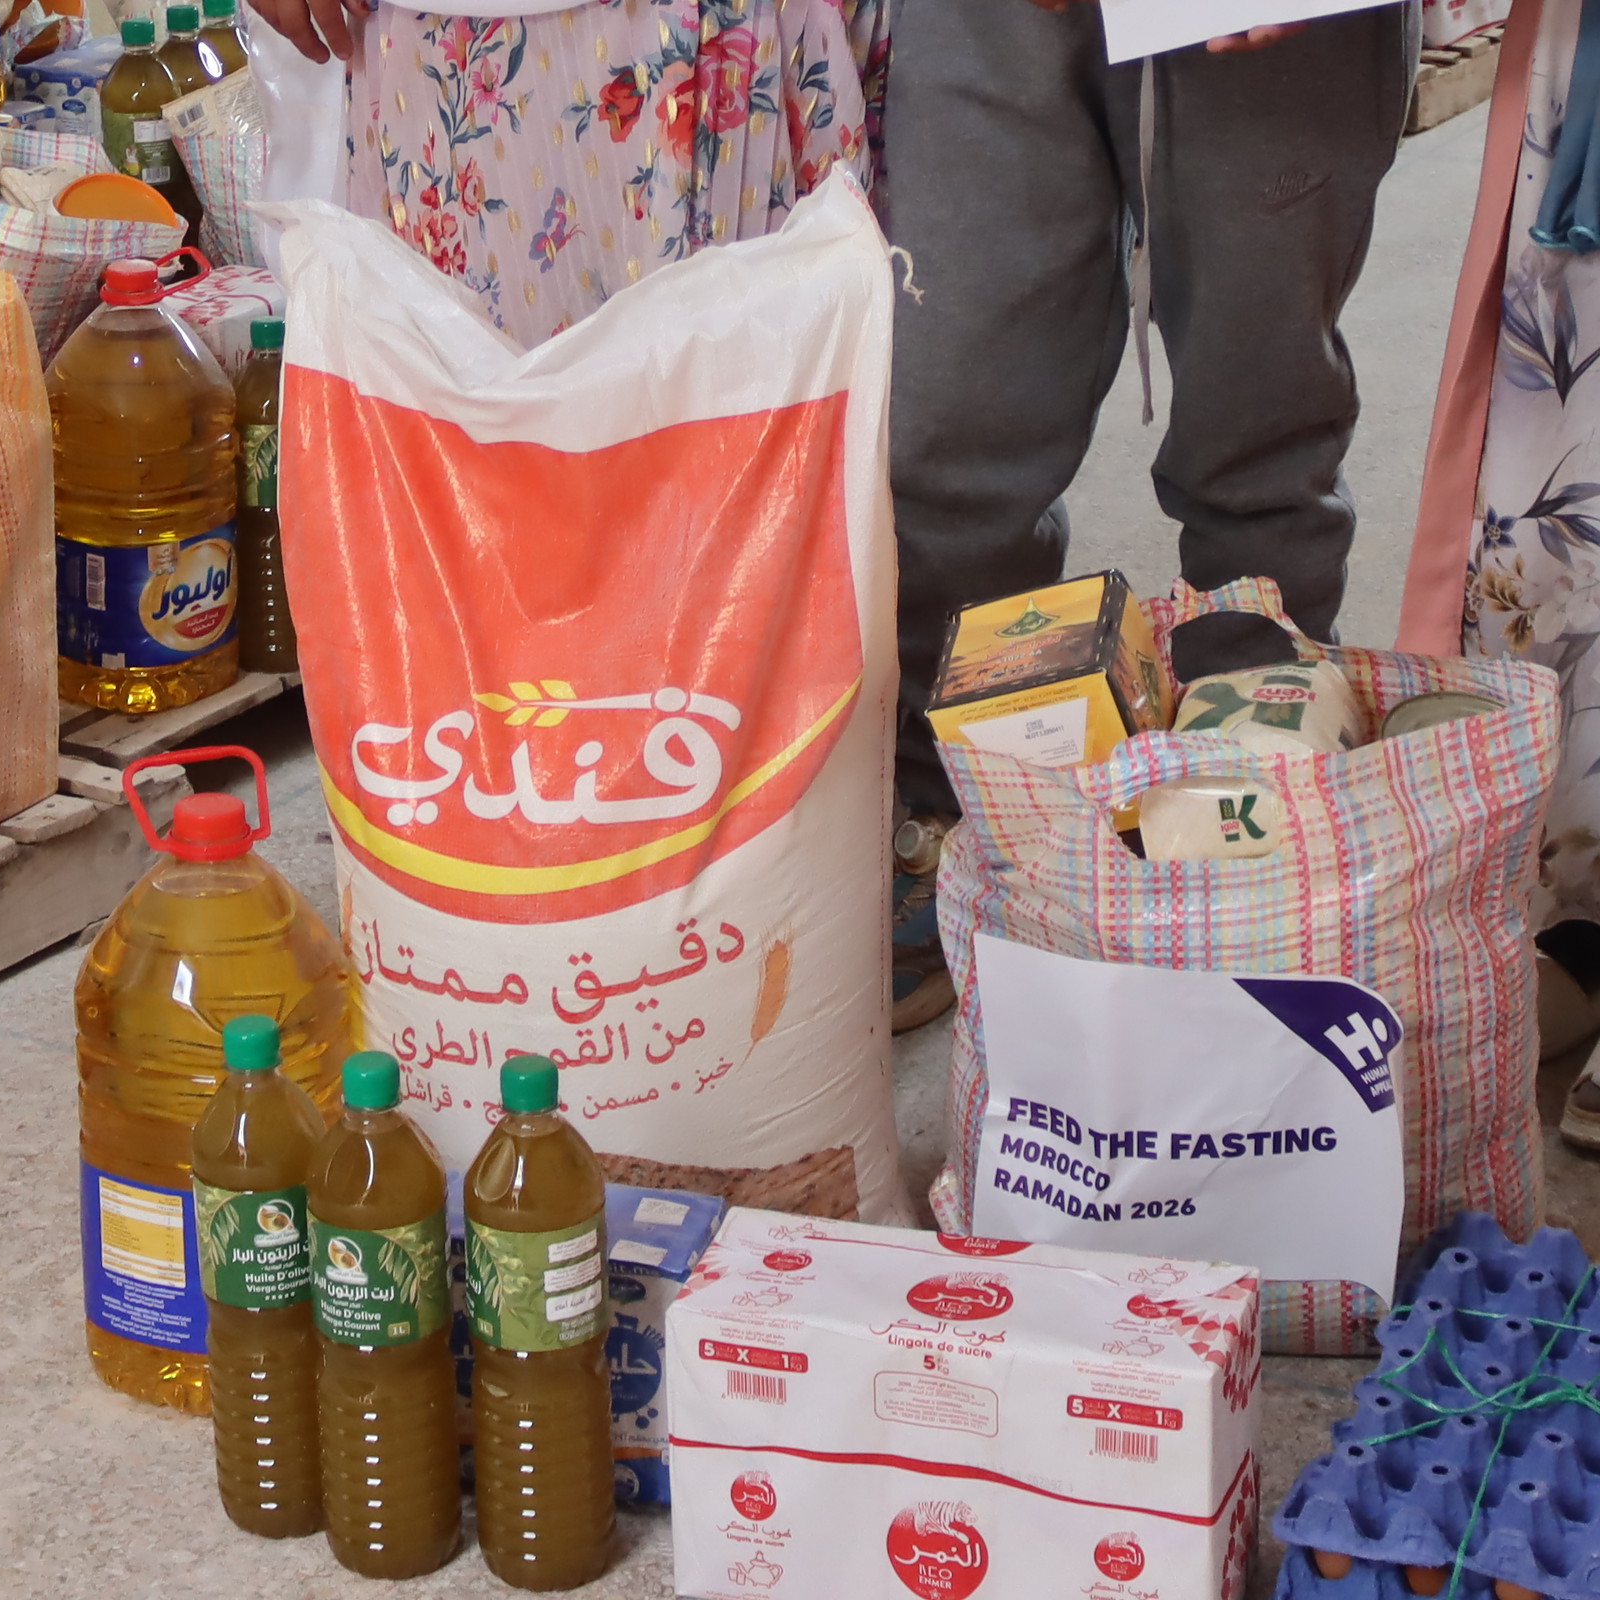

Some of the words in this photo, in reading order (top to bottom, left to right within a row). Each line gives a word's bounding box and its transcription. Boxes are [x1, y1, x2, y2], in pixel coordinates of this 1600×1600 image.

[358, 918, 530, 1006] ممتاز
[551, 917, 746, 1024] دقيق
[392, 1018, 493, 1075] الطري
[645, 1016, 706, 1065] من
[694, 1056, 734, 1095] خبز
[582, 1086, 660, 1119] مسمن
[1006, 1096, 1082, 1145] FEED
[1087, 1128, 1158, 1161] THE
[1169, 1126, 1337, 1160] FASTING
[999, 1133, 1111, 1191] MOROCCO
[993, 1167, 1122, 1222] RAMADAN
[1130, 1197, 1197, 1220] 2026
[256, 1244, 300, 1263] الزيتون
[245, 1273, 275, 1283] Huile
[246, 1284, 277, 1295] Vierge
[327, 1282, 368, 1302] الزيتون
[370, 1286, 395, 1301] زيت
[913, 1288, 1007, 1309] النمر
[320, 1299, 341, 1319] Huile
[343, 1309, 382, 1322] D'olive
[321, 1311, 343, 1328] Vierge
[343, 1321, 381, 1332] Courant
[393, 1326, 406, 1336] 1L
[703, 1341, 717, 1358] 5
[736, 1348, 751, 1364] X
[781, 1353, 791, 1370] 1
[888, 1334, 933, 1351] Lingots
[937, 1340, 955, 1353] de
[958, 1344, 993, 1360] sucre
[611, 1343, 658, 1381] حلي
[923, 1354, 937, 1371] 5
[1071, 1398, 1085, 1415] 5
[1106, 1403, 1122, 1420] X
[1155, 1409, 1164, 1426] 1
[1163, 1416, 1178, 1429] Kg
[726, 1533, 752, 1543] Lingots
[753, 1537, 764, 1545] de
[765, 1540, 786, 1548] sucre
[894, 1541, 983, 1569] النمر
[918, 1575, 953, 1590] ENMER
